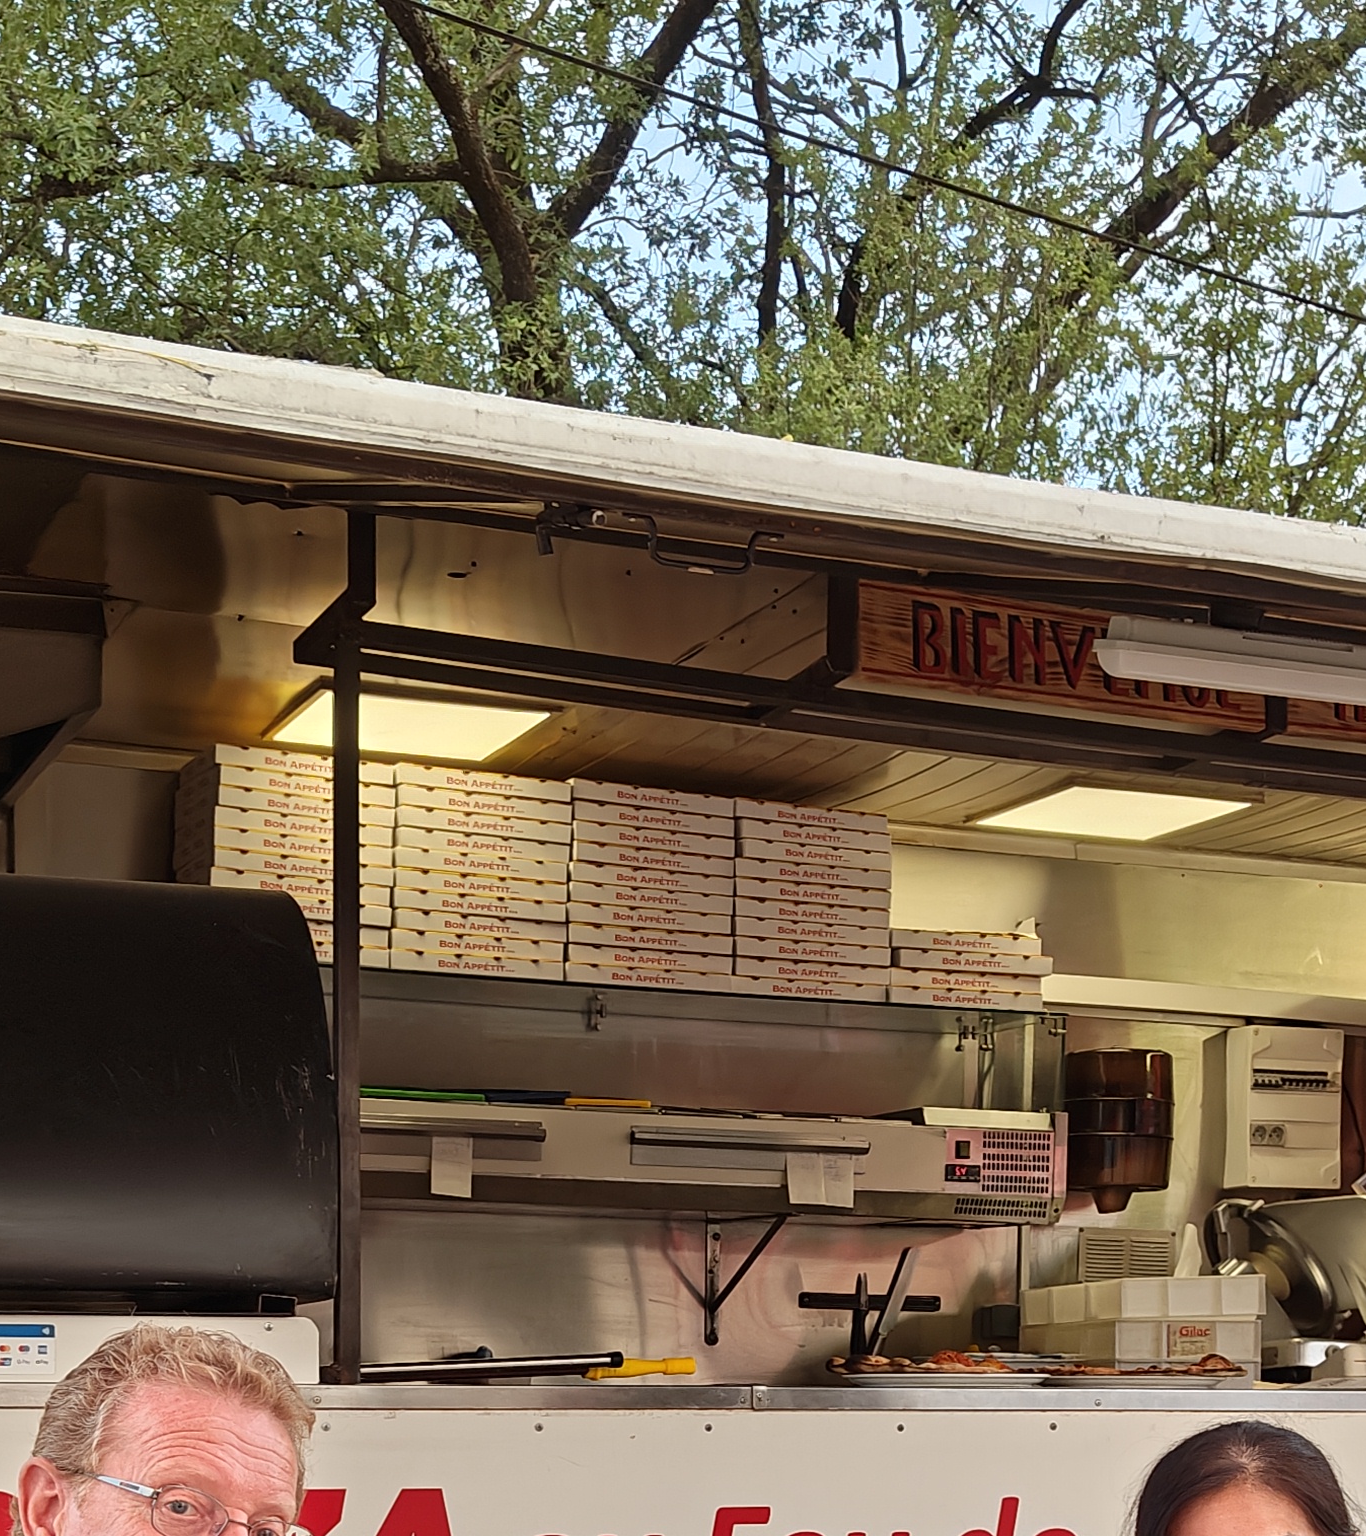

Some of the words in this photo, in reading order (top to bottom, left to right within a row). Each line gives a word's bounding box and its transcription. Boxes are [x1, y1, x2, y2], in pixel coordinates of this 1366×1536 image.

[912, 600, 1242, 711] BIENV
[265, 757, 286, 768] BON
[269, 778, 290, 790] BON
[446, 776, 468, 787] BON
[617, 790, 637, 800] BON
[267, 799, 289, 810] BON
[448, 798, 470, 808] BON
[619, 812, 639, 822] BON
[777, 810, 797, 819] BON
[264, 819, 285, 830] BON
[447, 818, 469, 828] BON
[619, 832, 639, 842] BON
[783, 830, 802, 839] BON
[263, 839, 285, 851] BON
[447, 838, 468, 848] BON
[619, 853, 639, 863] BON
[785, 849, 805, 857] BON
[264, 860, 285, 872] BON
[444, 858, 465, 868] BON
[779, 868, 799, 877] BON
[616, 874, 637, 883] BON
[260, 880, 282, 892] BON
[444, 880, 465, 890] BON
[616, 892, 636, 902] BON
[780, 888, 800, 897] BON
[442, 900, 463, 910] BON
[613, 912, 634, 921] BON
[779, 908, 798, 917] BON
[444, 920, 466, 930] BON
[777, 927, 797, 935] BON
[614, 934, 635, 943] BON
[933, 938, 952, 946] BON
[439, 940, 460, 950] BON
[779, 946, 799, 955] BON
[614, 954, 635, 963] BON
[942, 957, 961, 965] BON
[438, 960, 459, 969] BON
[778, 967, 798, 975] BON
[612, 972, 632, 981] BON
[932, 977, 950, 985] BON
[772, 985, 792, 993] BON
[933, 994, 951, 1002] BON
